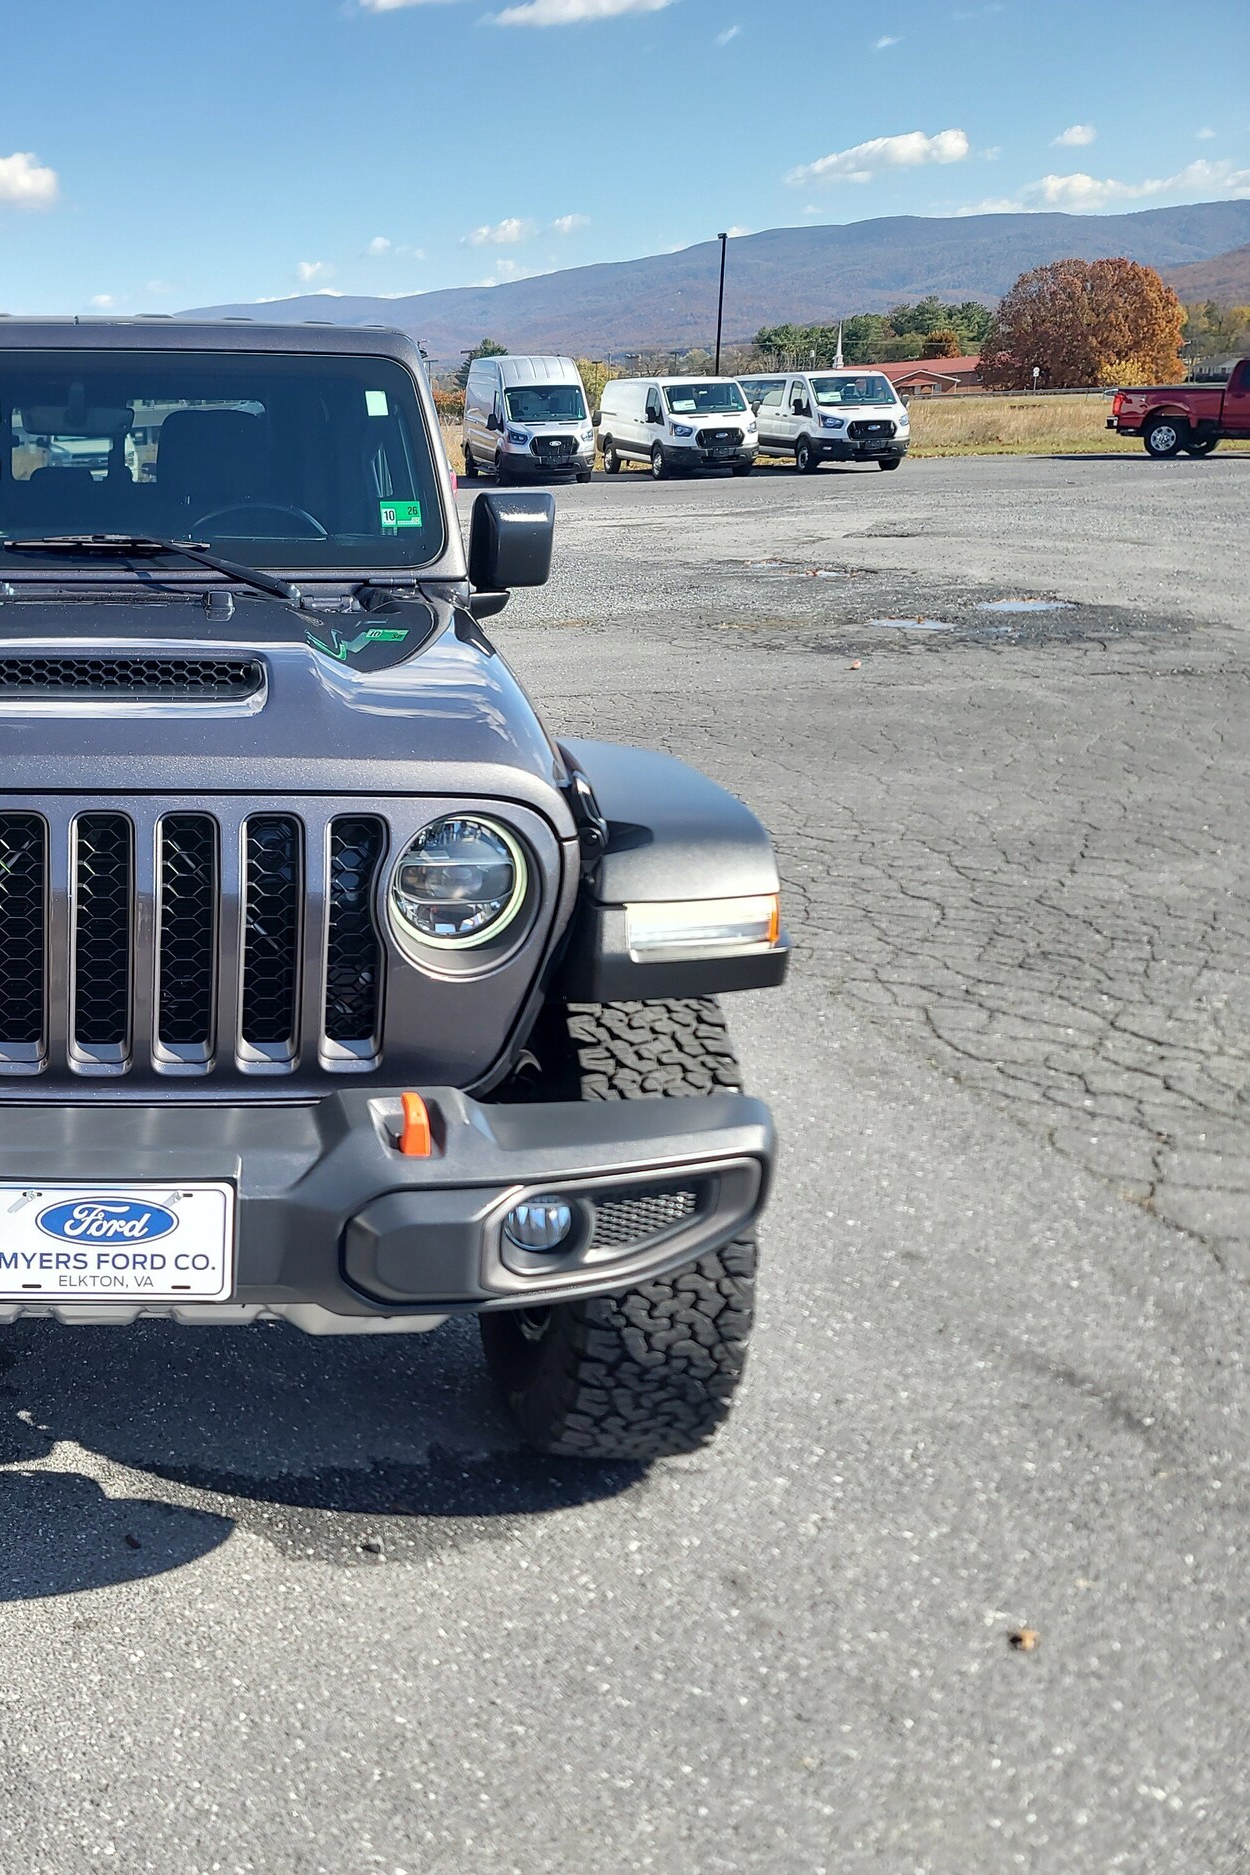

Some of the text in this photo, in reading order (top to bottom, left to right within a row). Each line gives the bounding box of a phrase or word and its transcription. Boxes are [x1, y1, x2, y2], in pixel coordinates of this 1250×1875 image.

[384, 510, 395, 521] 10
[407, 506, 418, 515] 26
[63, 1203, 152, 1238] Ford
[97, 1253, 166, 1271] FORD
[174, 1254, 217, 1271] CO.
[58, 1275, 154, 1289] ELKTON, VA
